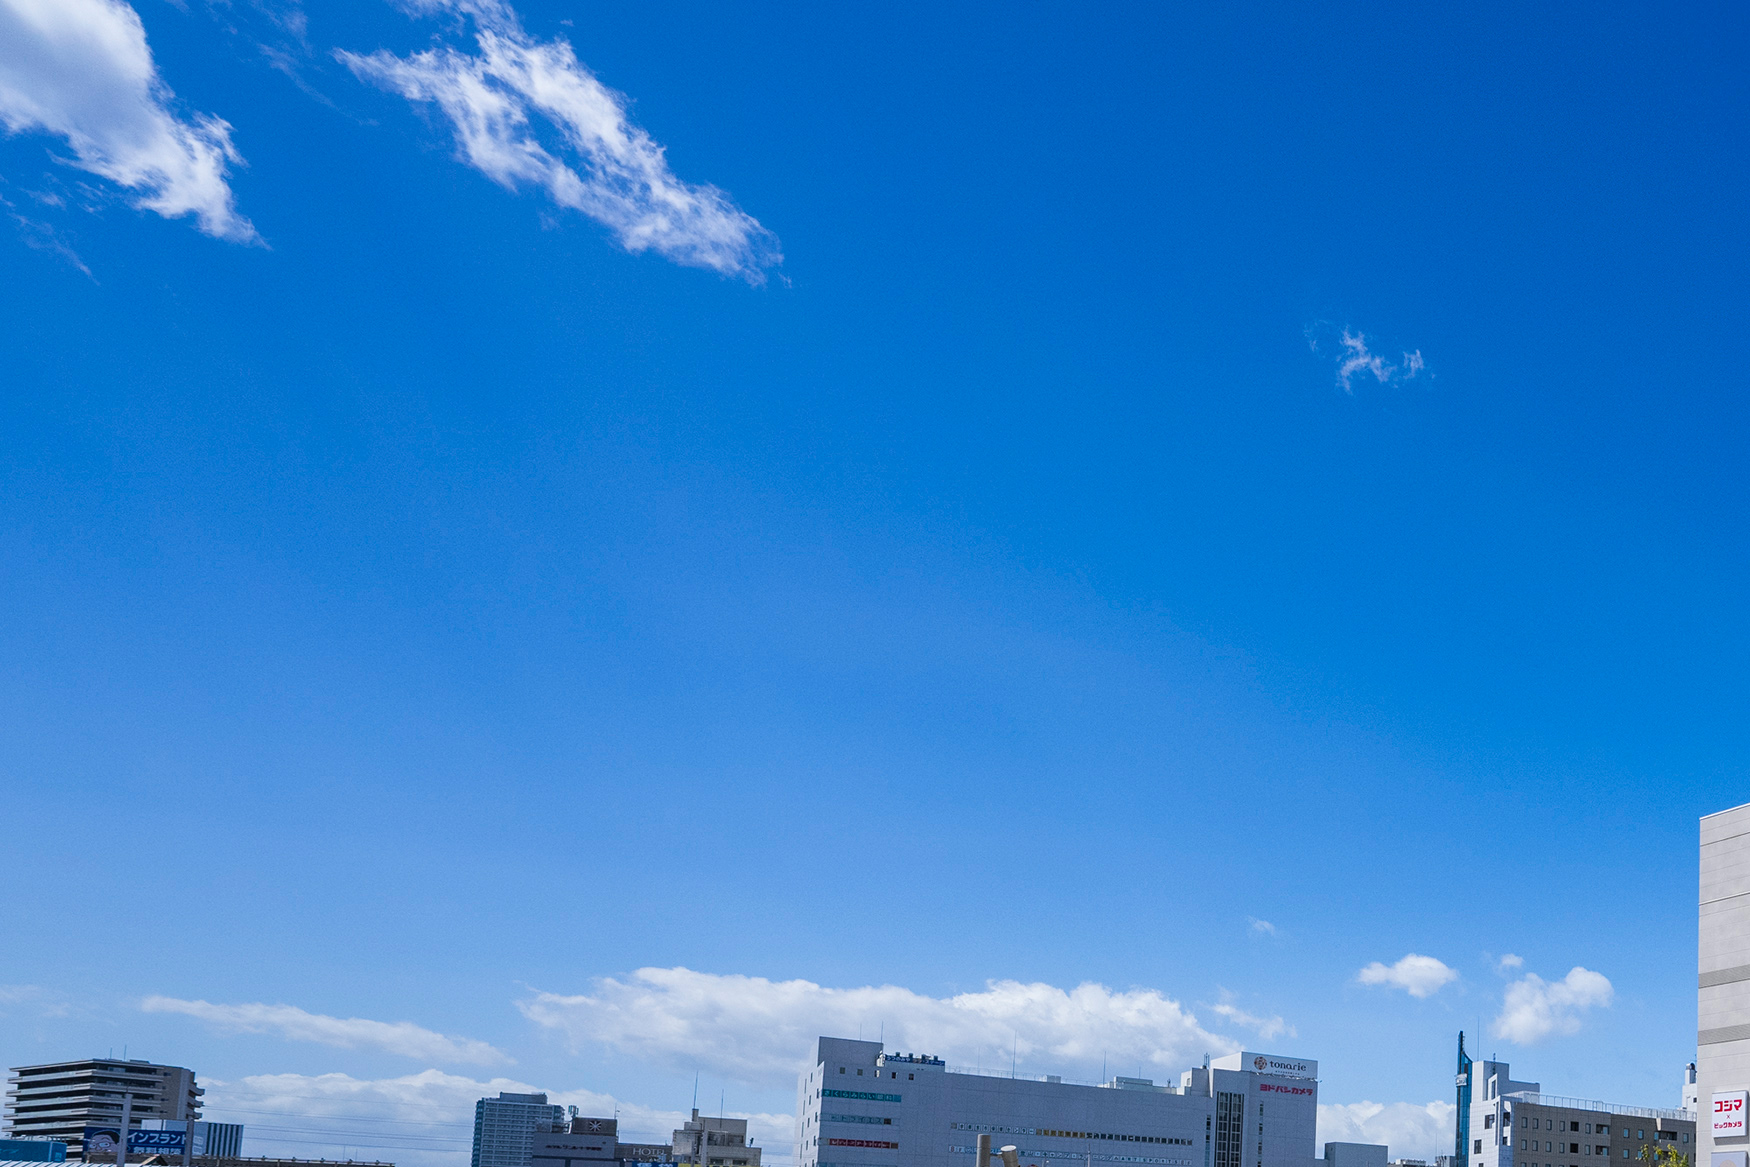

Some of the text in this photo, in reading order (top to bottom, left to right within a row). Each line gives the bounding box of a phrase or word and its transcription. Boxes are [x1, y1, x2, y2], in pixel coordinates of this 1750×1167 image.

[1270, 1060, 1307, 1072] tonarie
[1260, 1083, 1314, 1096] ヨドバシカメラ
[1714, 1099, 1742, 1113] コジマ
[1713, 1121, 1742, 1129] ビックカメラ
[632, 1147, 665, 1156] HOTEL
